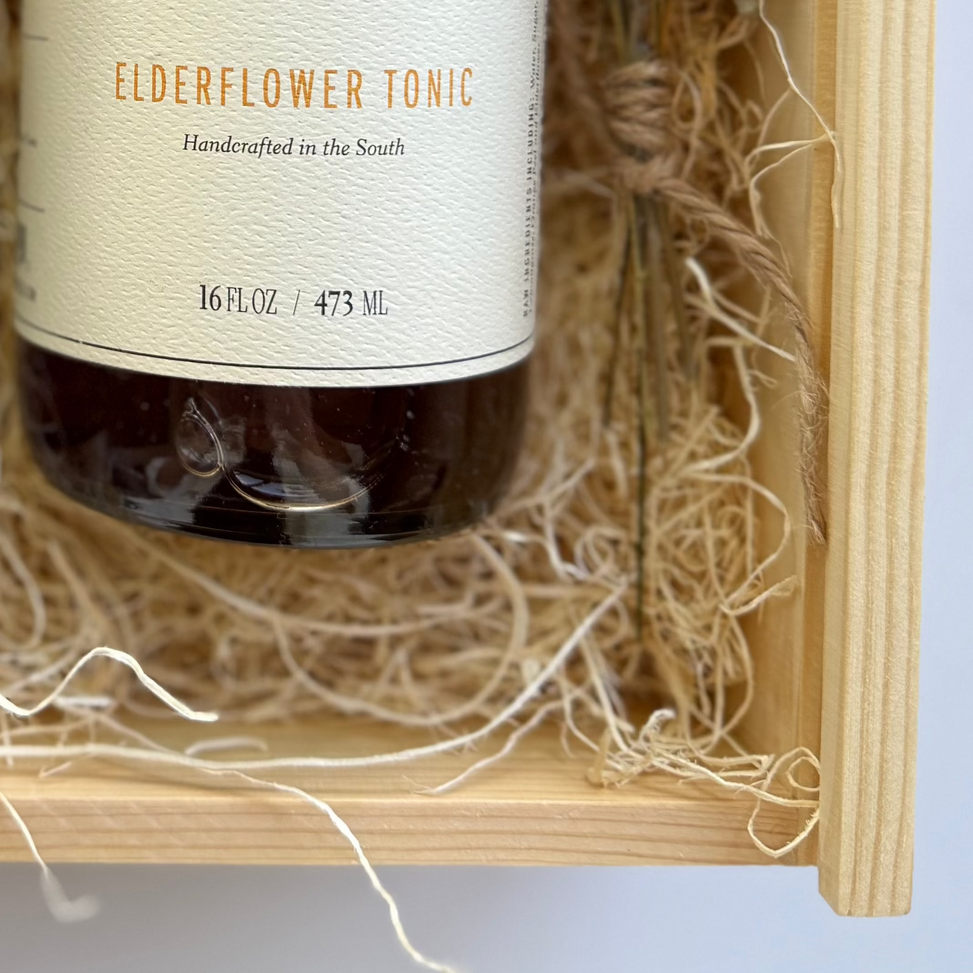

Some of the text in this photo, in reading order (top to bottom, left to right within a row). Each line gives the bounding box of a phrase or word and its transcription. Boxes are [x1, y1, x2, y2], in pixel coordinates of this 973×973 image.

[115, 61, 473, 109] ELDERFLOWER TONIC
[182, 133, 406, 159] Handcrafted in the South
[313, 289, 353, 317] 473
[362, 289, 389, 316] ML
